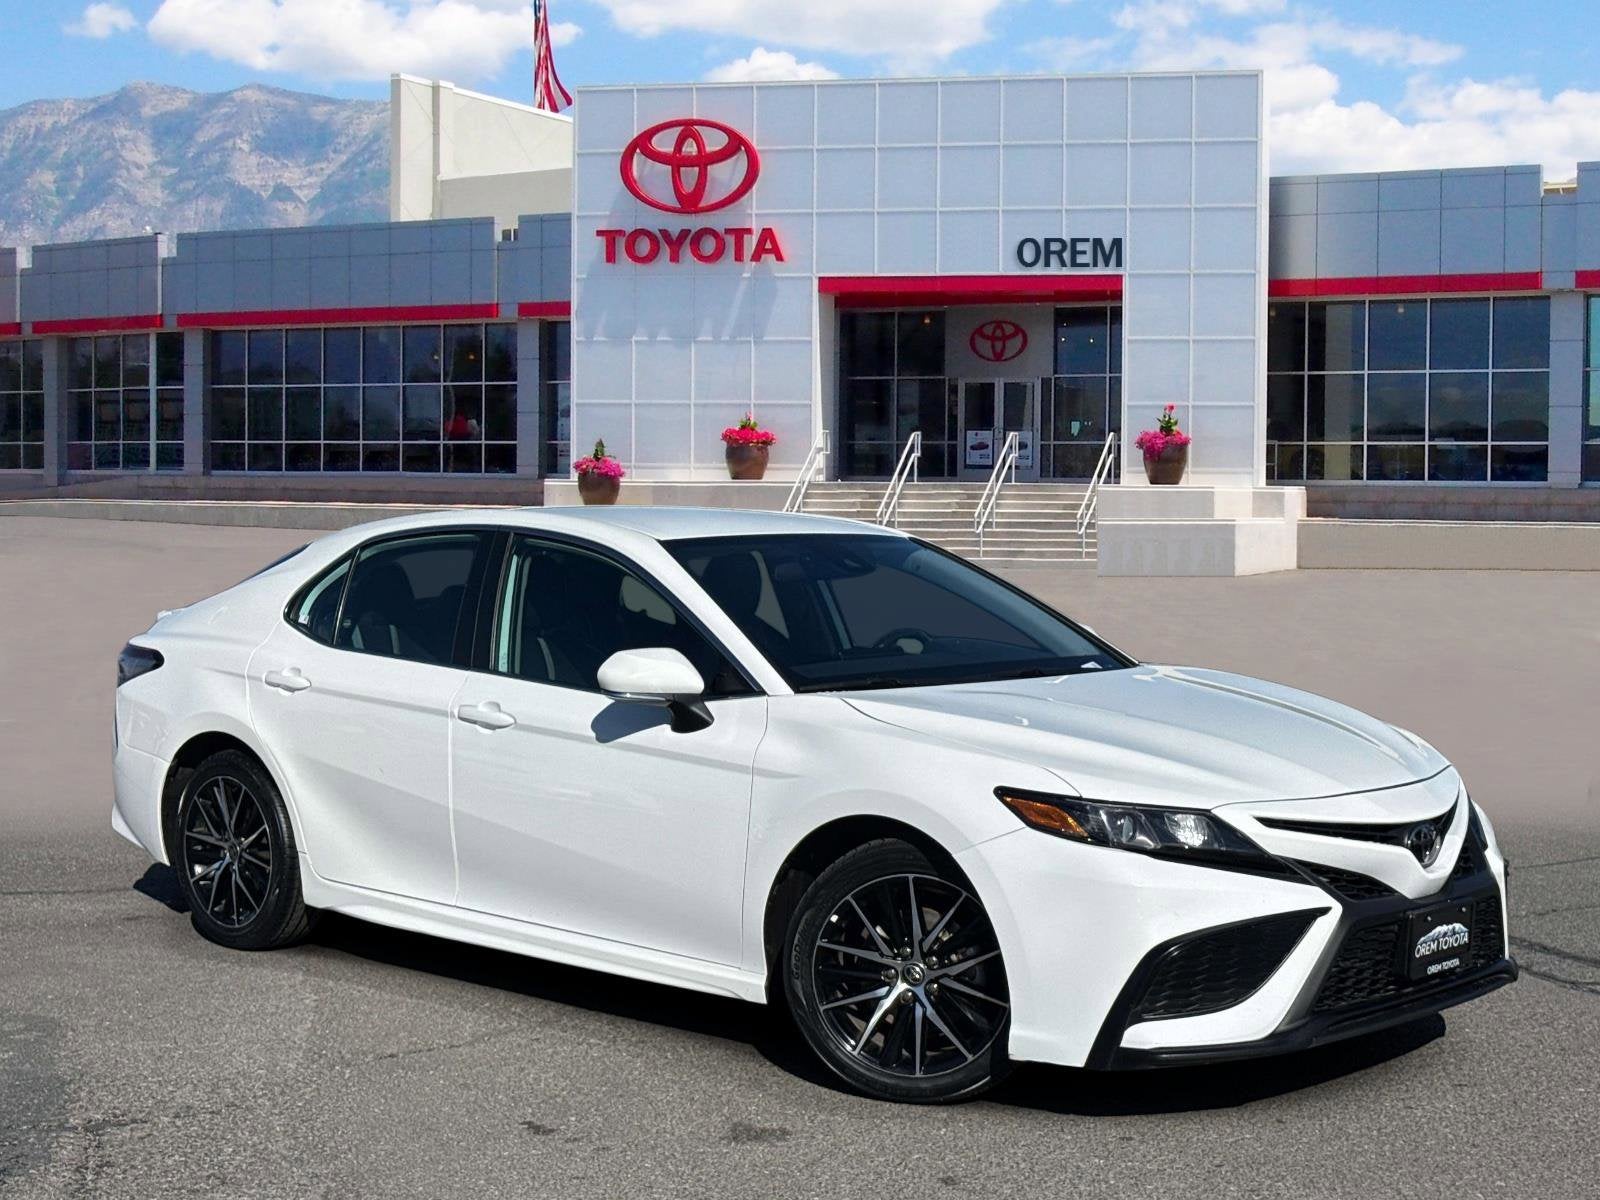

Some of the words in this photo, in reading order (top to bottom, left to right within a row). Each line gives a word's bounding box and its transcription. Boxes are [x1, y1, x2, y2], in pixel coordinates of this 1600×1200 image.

[596, 227, 784, 264] TOYOTA
[1016, 237, 1123, 268] OREM
[1414, 940, 1438, 958] OREM
[1438, 932, 1469, 951] TOYOTA
[1427, 963, 1442, 975] OREM
[1442, 958, 1460, 970] TOYOTA
